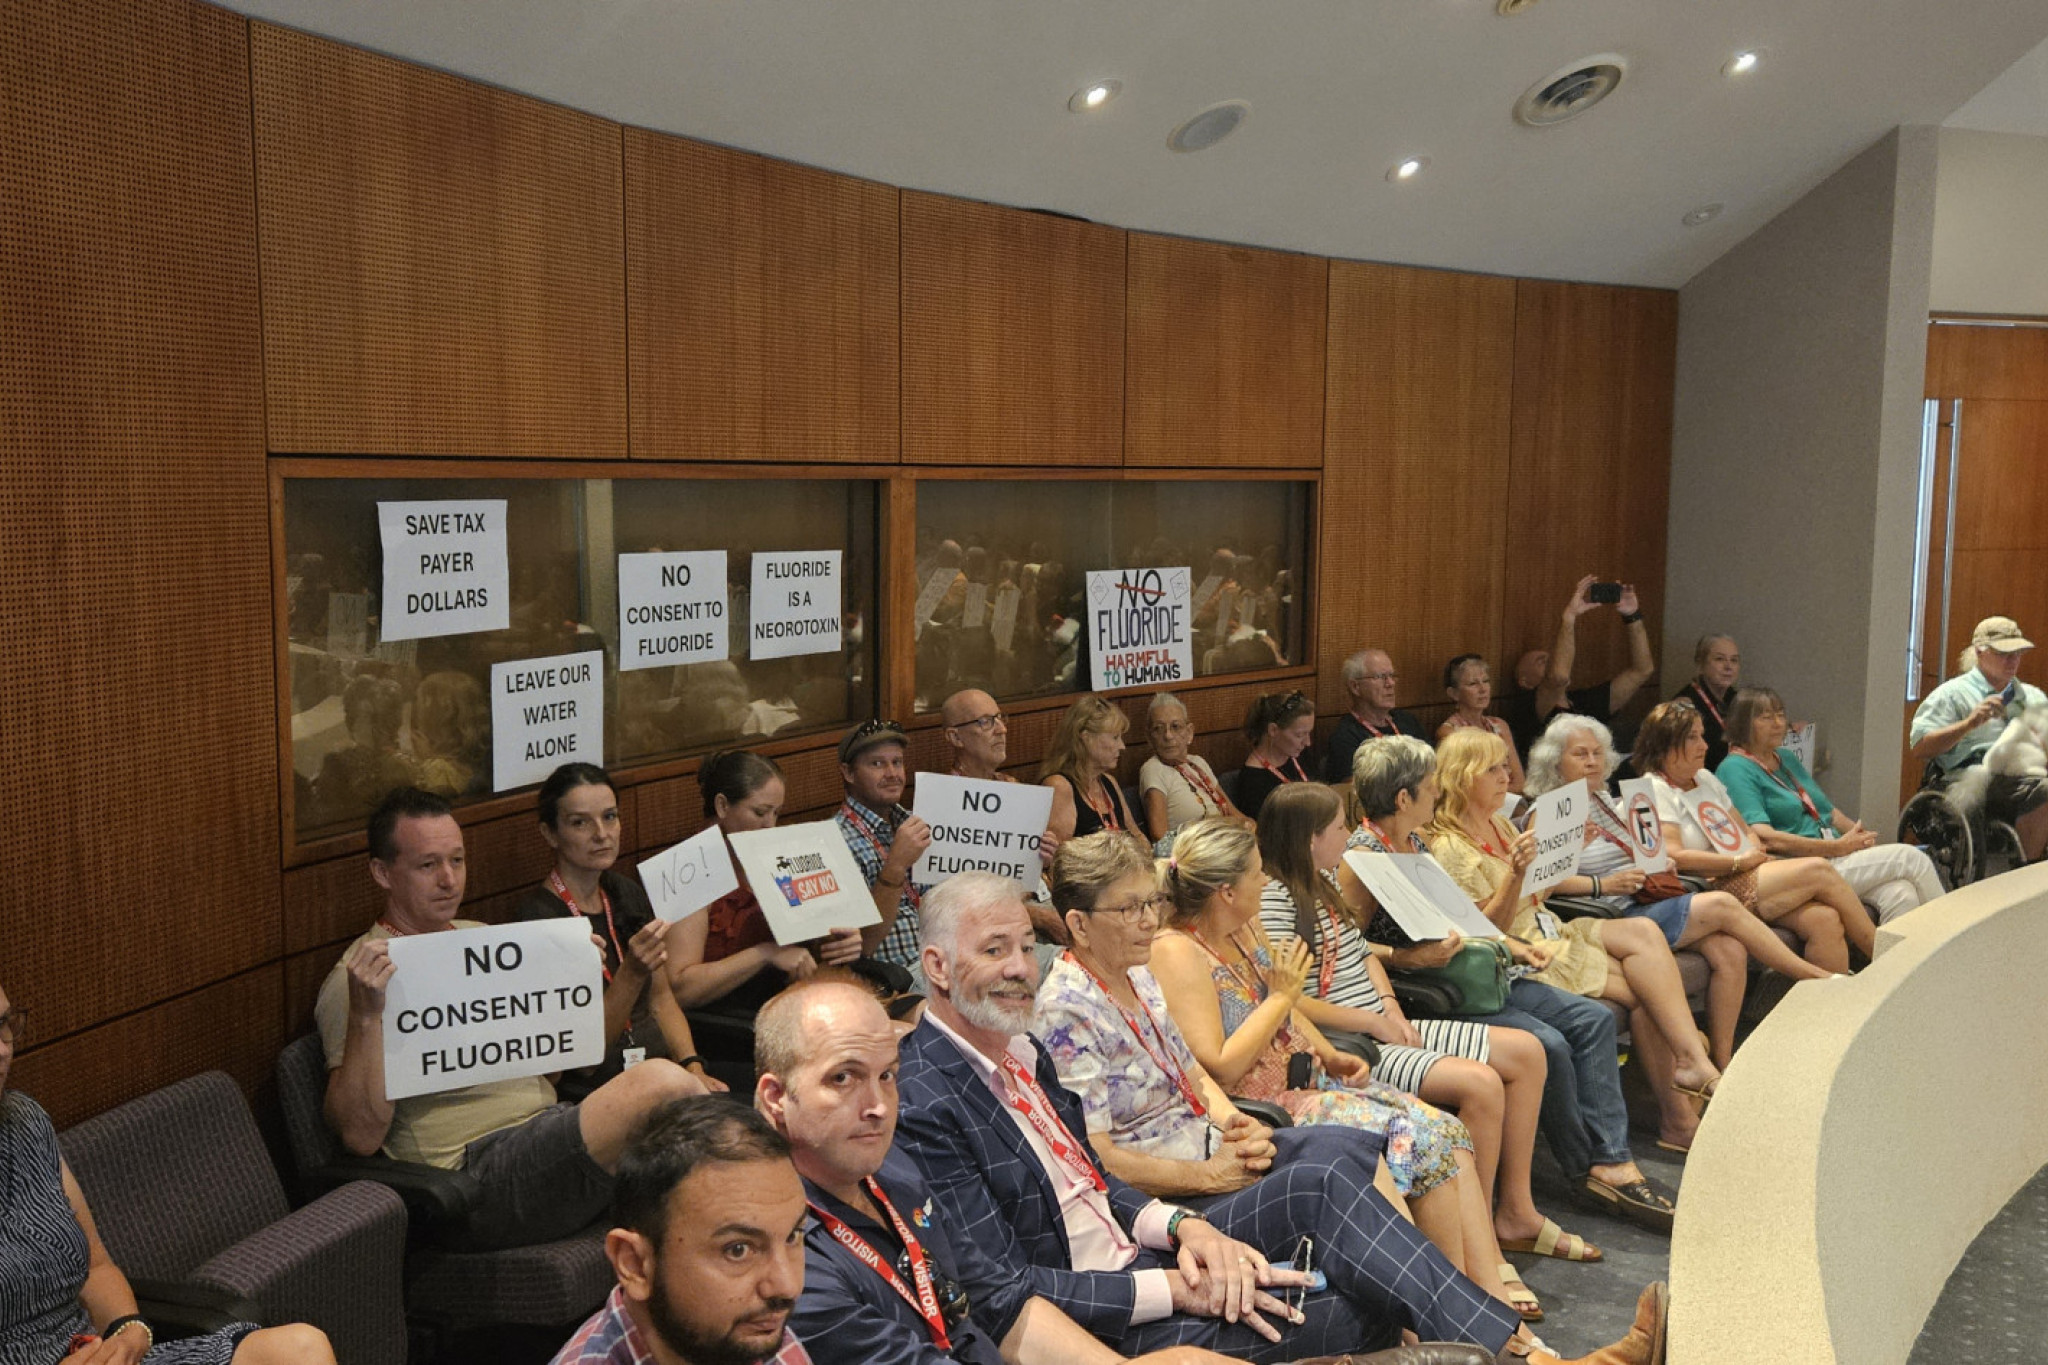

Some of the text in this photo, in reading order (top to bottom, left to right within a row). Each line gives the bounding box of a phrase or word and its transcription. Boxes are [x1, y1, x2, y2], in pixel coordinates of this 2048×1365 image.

[406, 513, 485, 535] SAVE TAX
[420, 552, 474, 575] PAYER
[661, 564, 691, 587] NO
[766, 561, 831, 579] FLUORIDE
[407, 588, 488, 615] DOLLARS
[788, 591, 812, 607] IS A
[1119, 569, 1162, 609] NO
[627, 601, 723, 625] CONSENT TO
[755, 618, 839, 639] NEOROTOXIN
[1098, 604, 1183, 651] FLUORIDE
[638, 633, 714, 656] FLUORIDE
[1106, 649, 1176, 670] HARMFUL
[506, 664, 591, 694] LEAVE OUR
[1103, 663, 1180, 687] TO HUMANS
[523, 700, 577, 726] WATER
[525, 733, 577, 761] ALONE
[962, 790, 1002, 813] NO
[1556, 797, 1572, 820] NO
[1635, 807, 1651, 845] F
[1017, 833, 1041, 851] TO
[661, 846, 711, 901] NO!
[928, 855, 1025, 880] FLUORIDE
[1533, 853, 1575, 883] FLUORIDE
[798, 874, 836, 900] SAY NO
[464, 941, 523, 976] NO
[397, 985, 592, 1034] CONSENT TO
[421, 1030, 574, 1075] FLUORIDE
[1064, 1149, 1093, 1177] VISITOR
[833, 1224, 881, 1268] VISITOR
[913, 1260, 938, 1319] VISITOR
